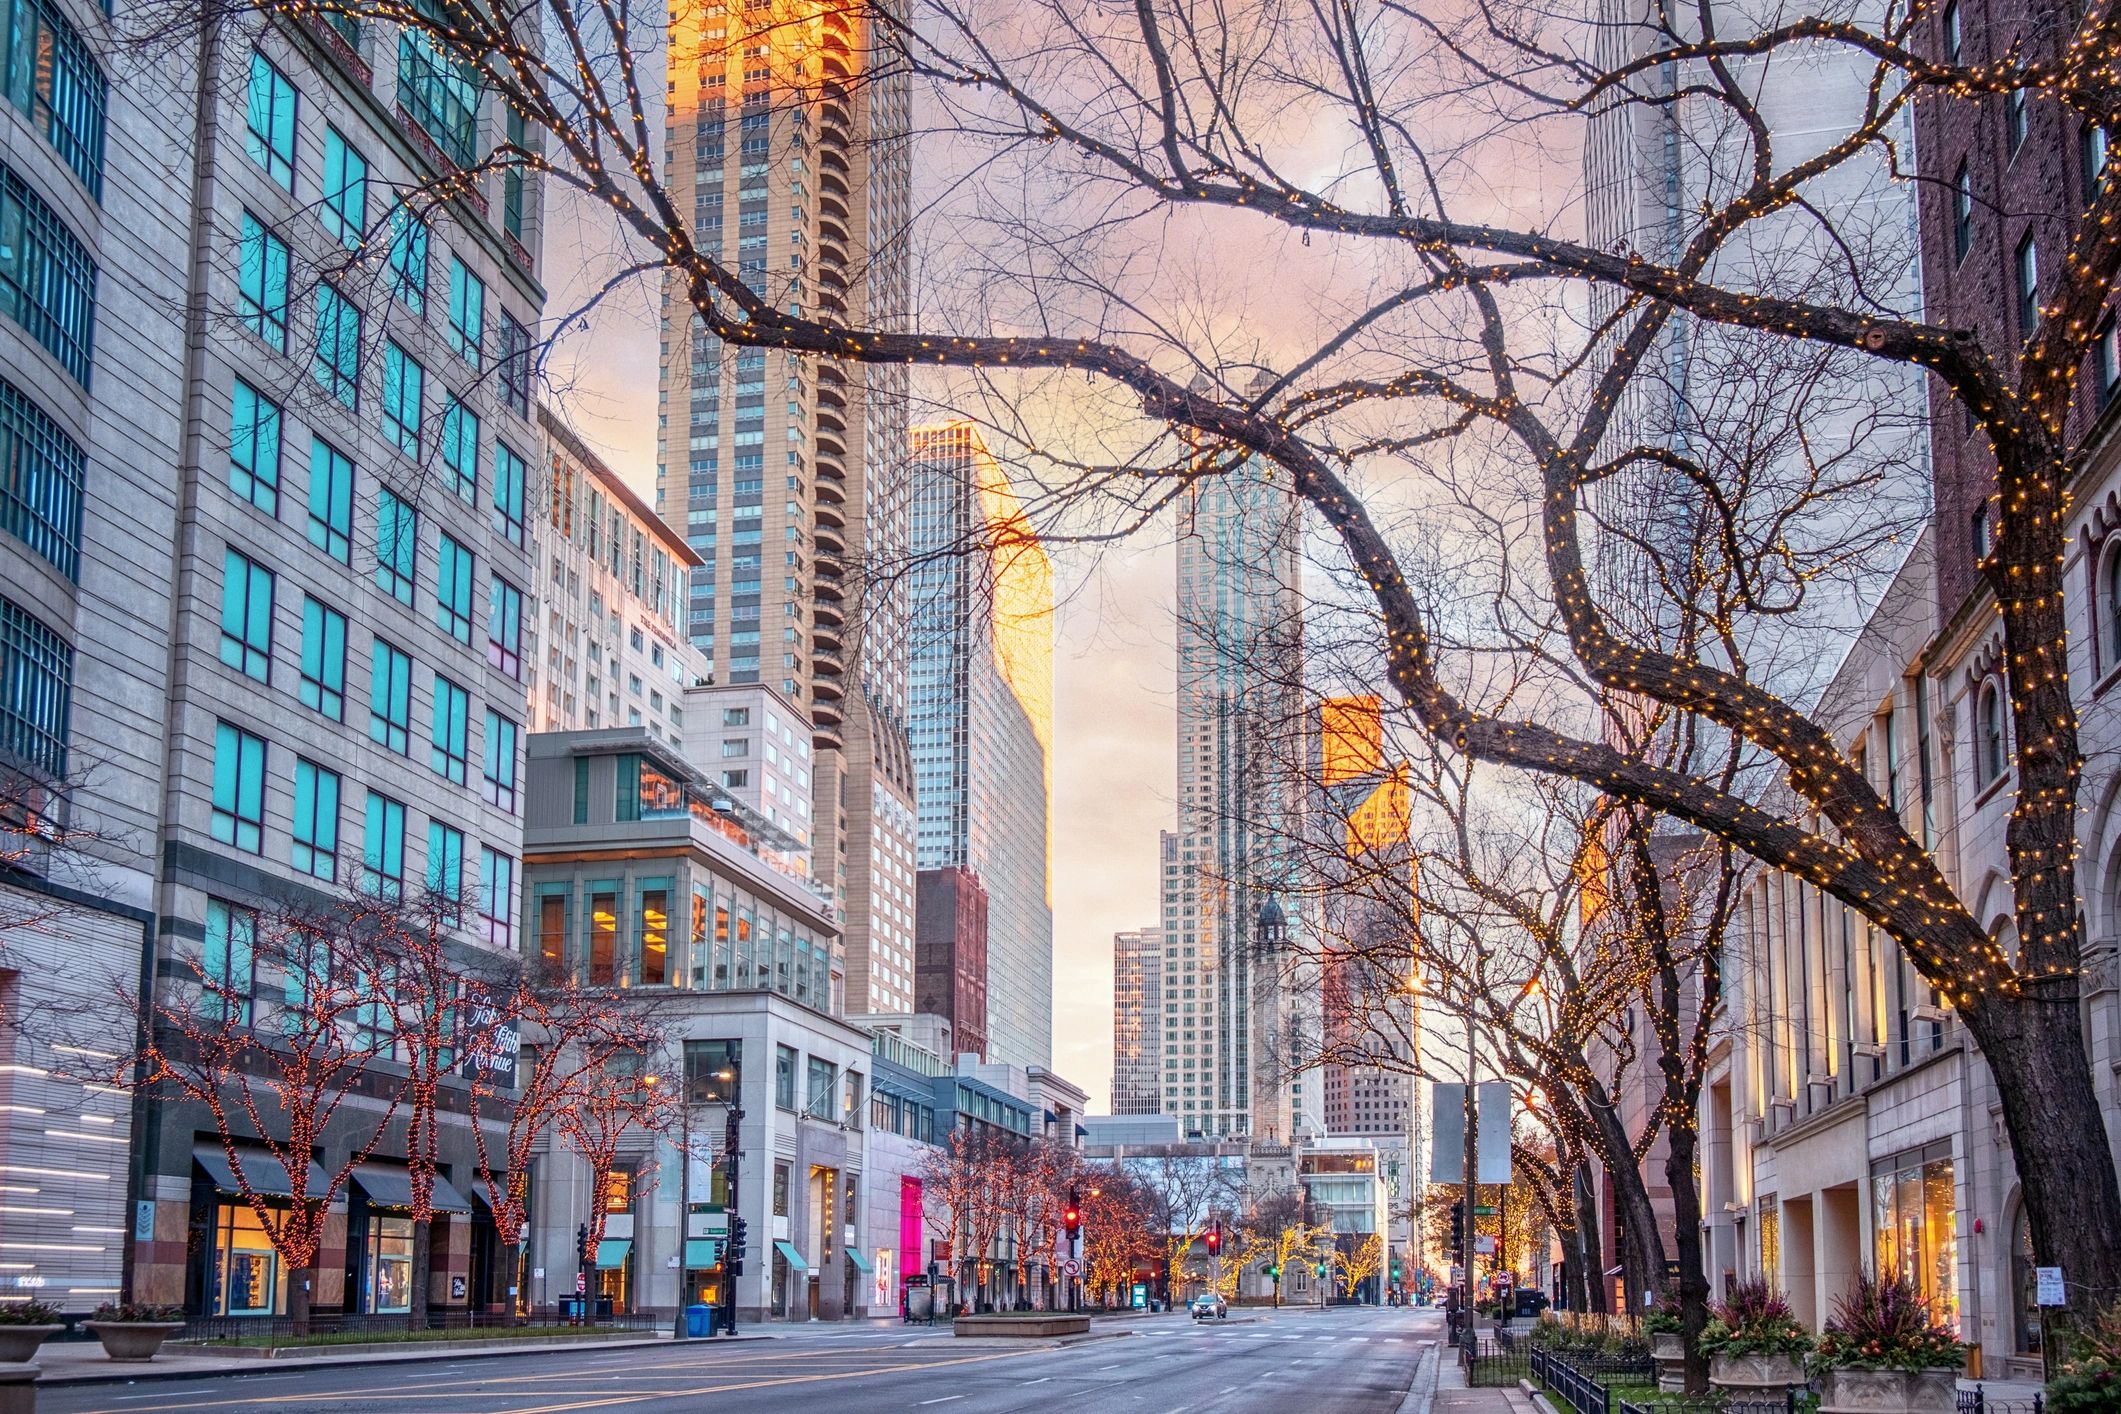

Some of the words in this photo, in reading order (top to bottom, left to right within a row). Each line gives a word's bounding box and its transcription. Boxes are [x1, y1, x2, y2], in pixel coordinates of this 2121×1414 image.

[640, 614, 651, 629] THE
[490, 1024, 518, 1054] Fifth
[1378, 1149, 1400, 1161] 00
